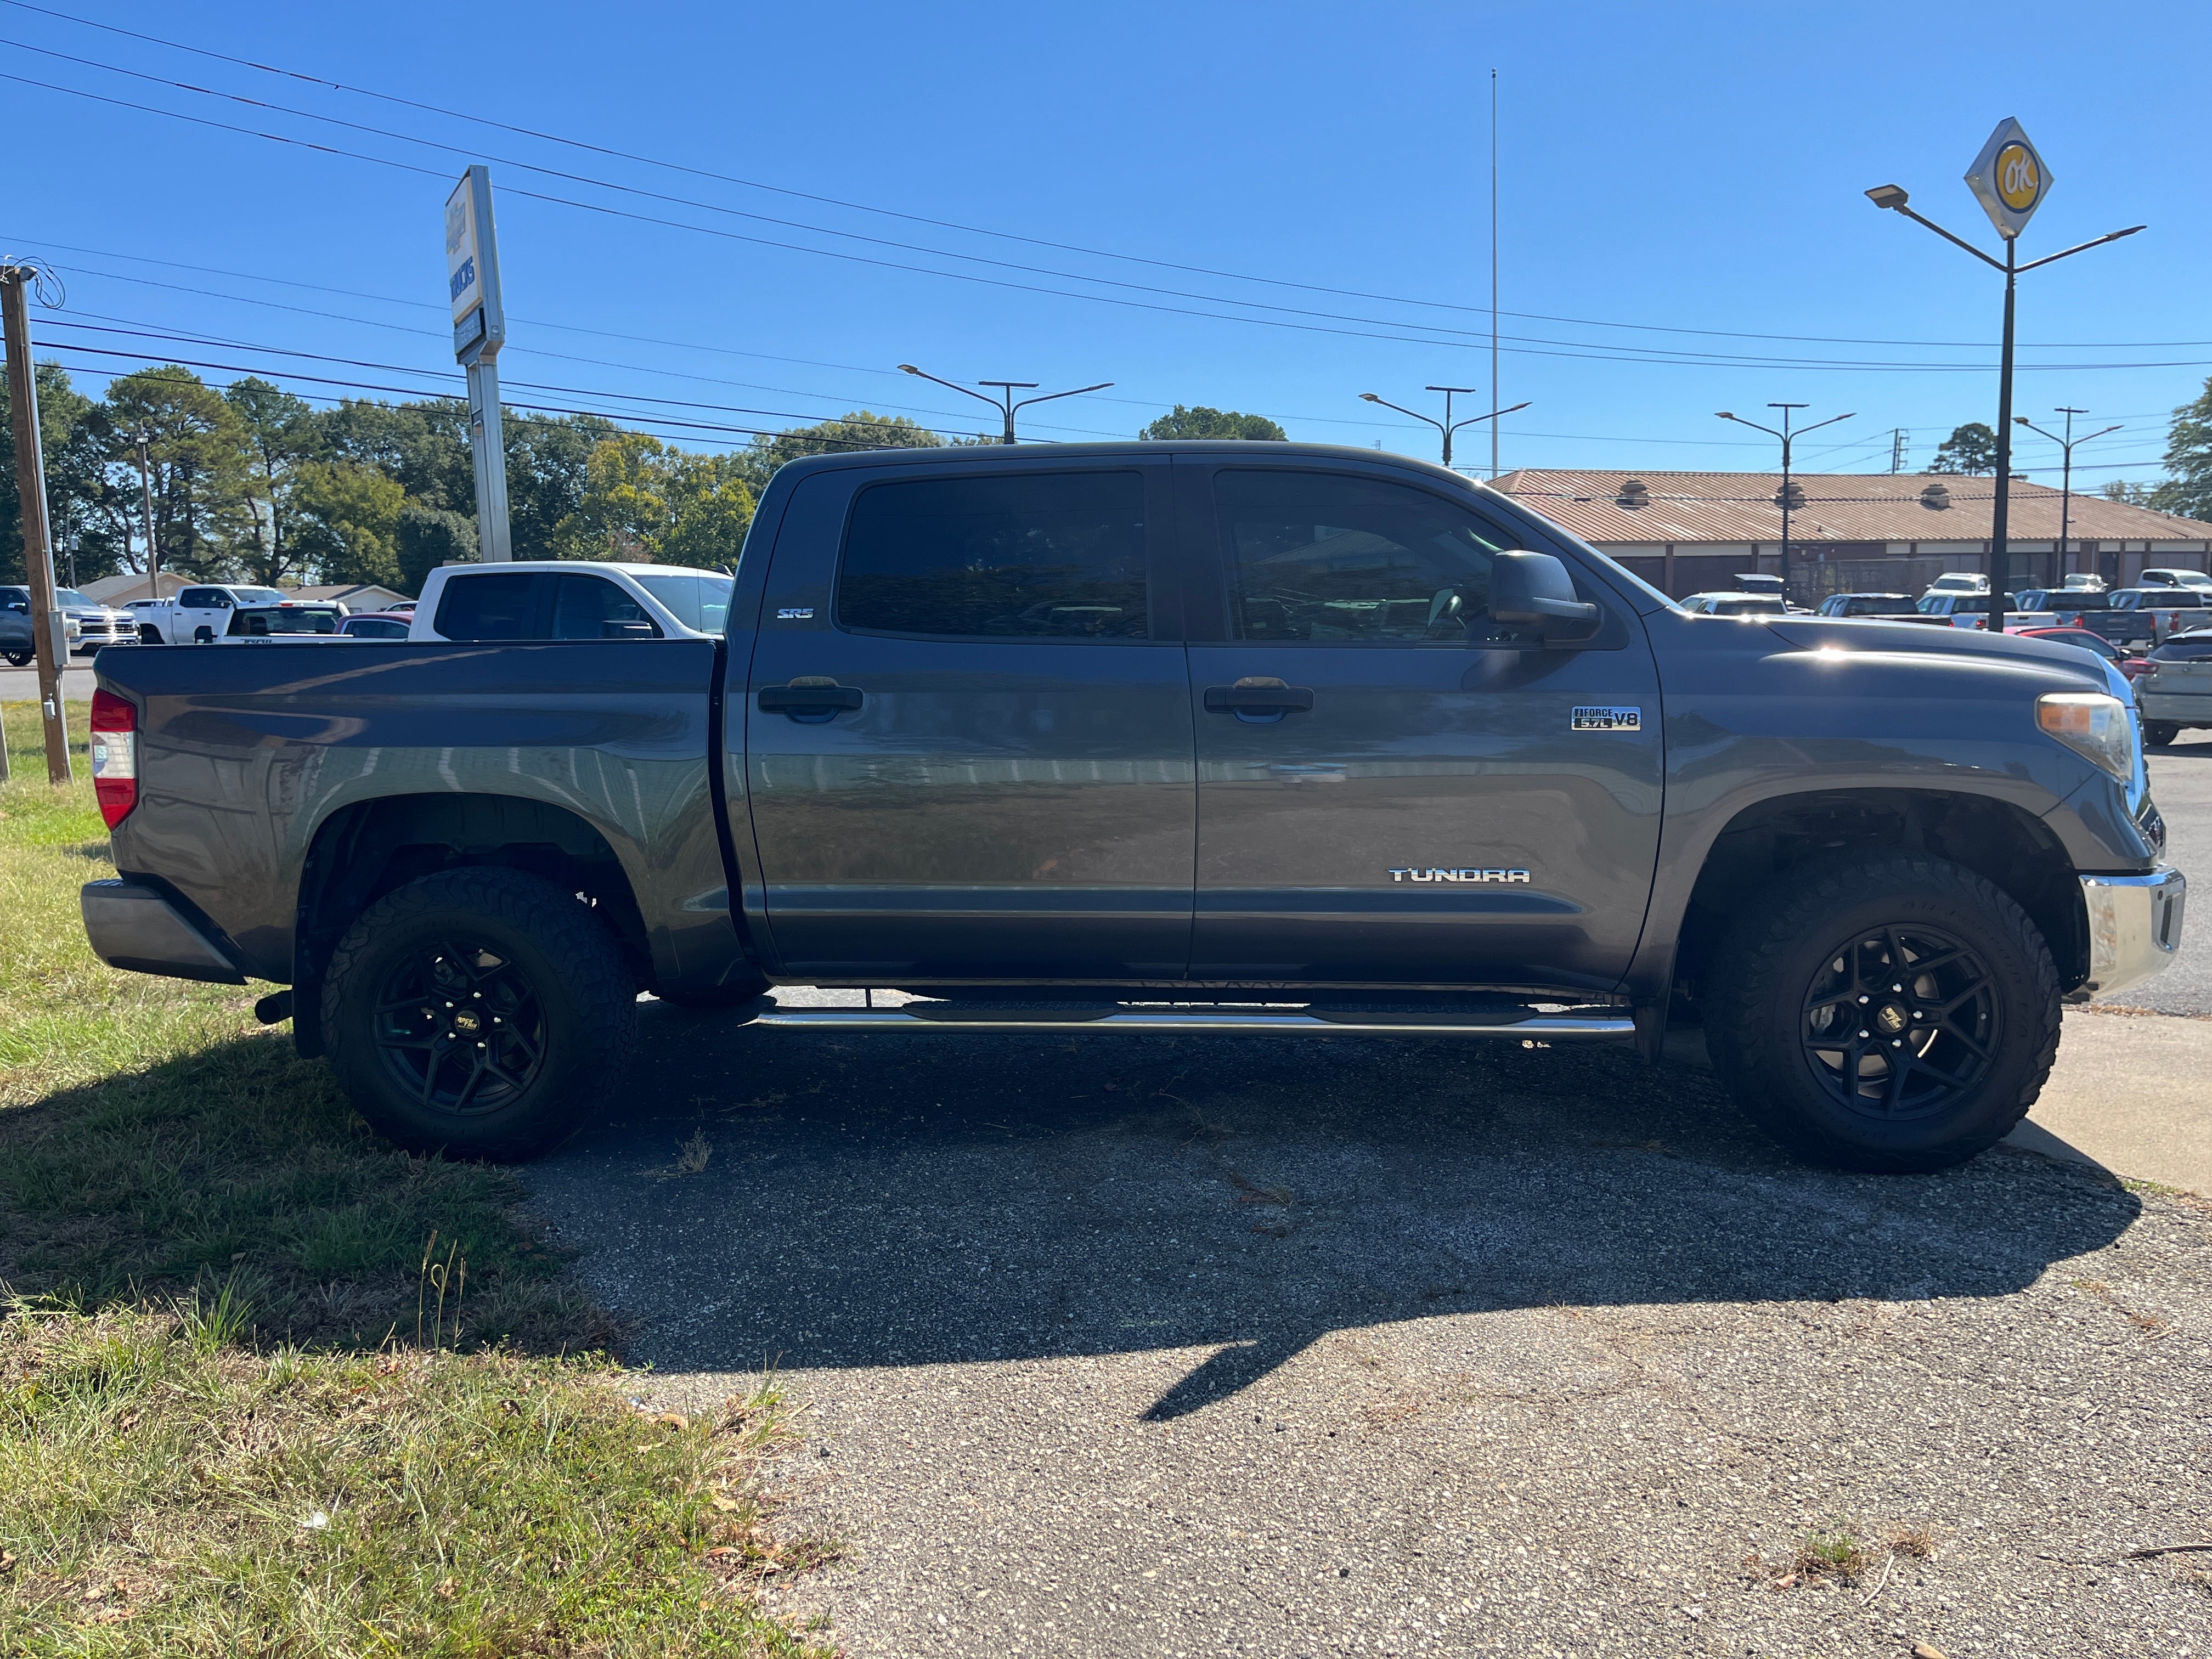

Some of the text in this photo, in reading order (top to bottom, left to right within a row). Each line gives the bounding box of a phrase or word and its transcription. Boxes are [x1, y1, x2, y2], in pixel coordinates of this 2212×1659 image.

[2005, 153, 2035, 194] OK
[450, 255, 475, 302] TRUCKS
[777, 608, 814, 619] SR5
[1581, 718, 1608, 728] 5.7L
[1613, 713, 1638, 726] V8
[1386, 867, 1530, 883] TUNDRA
